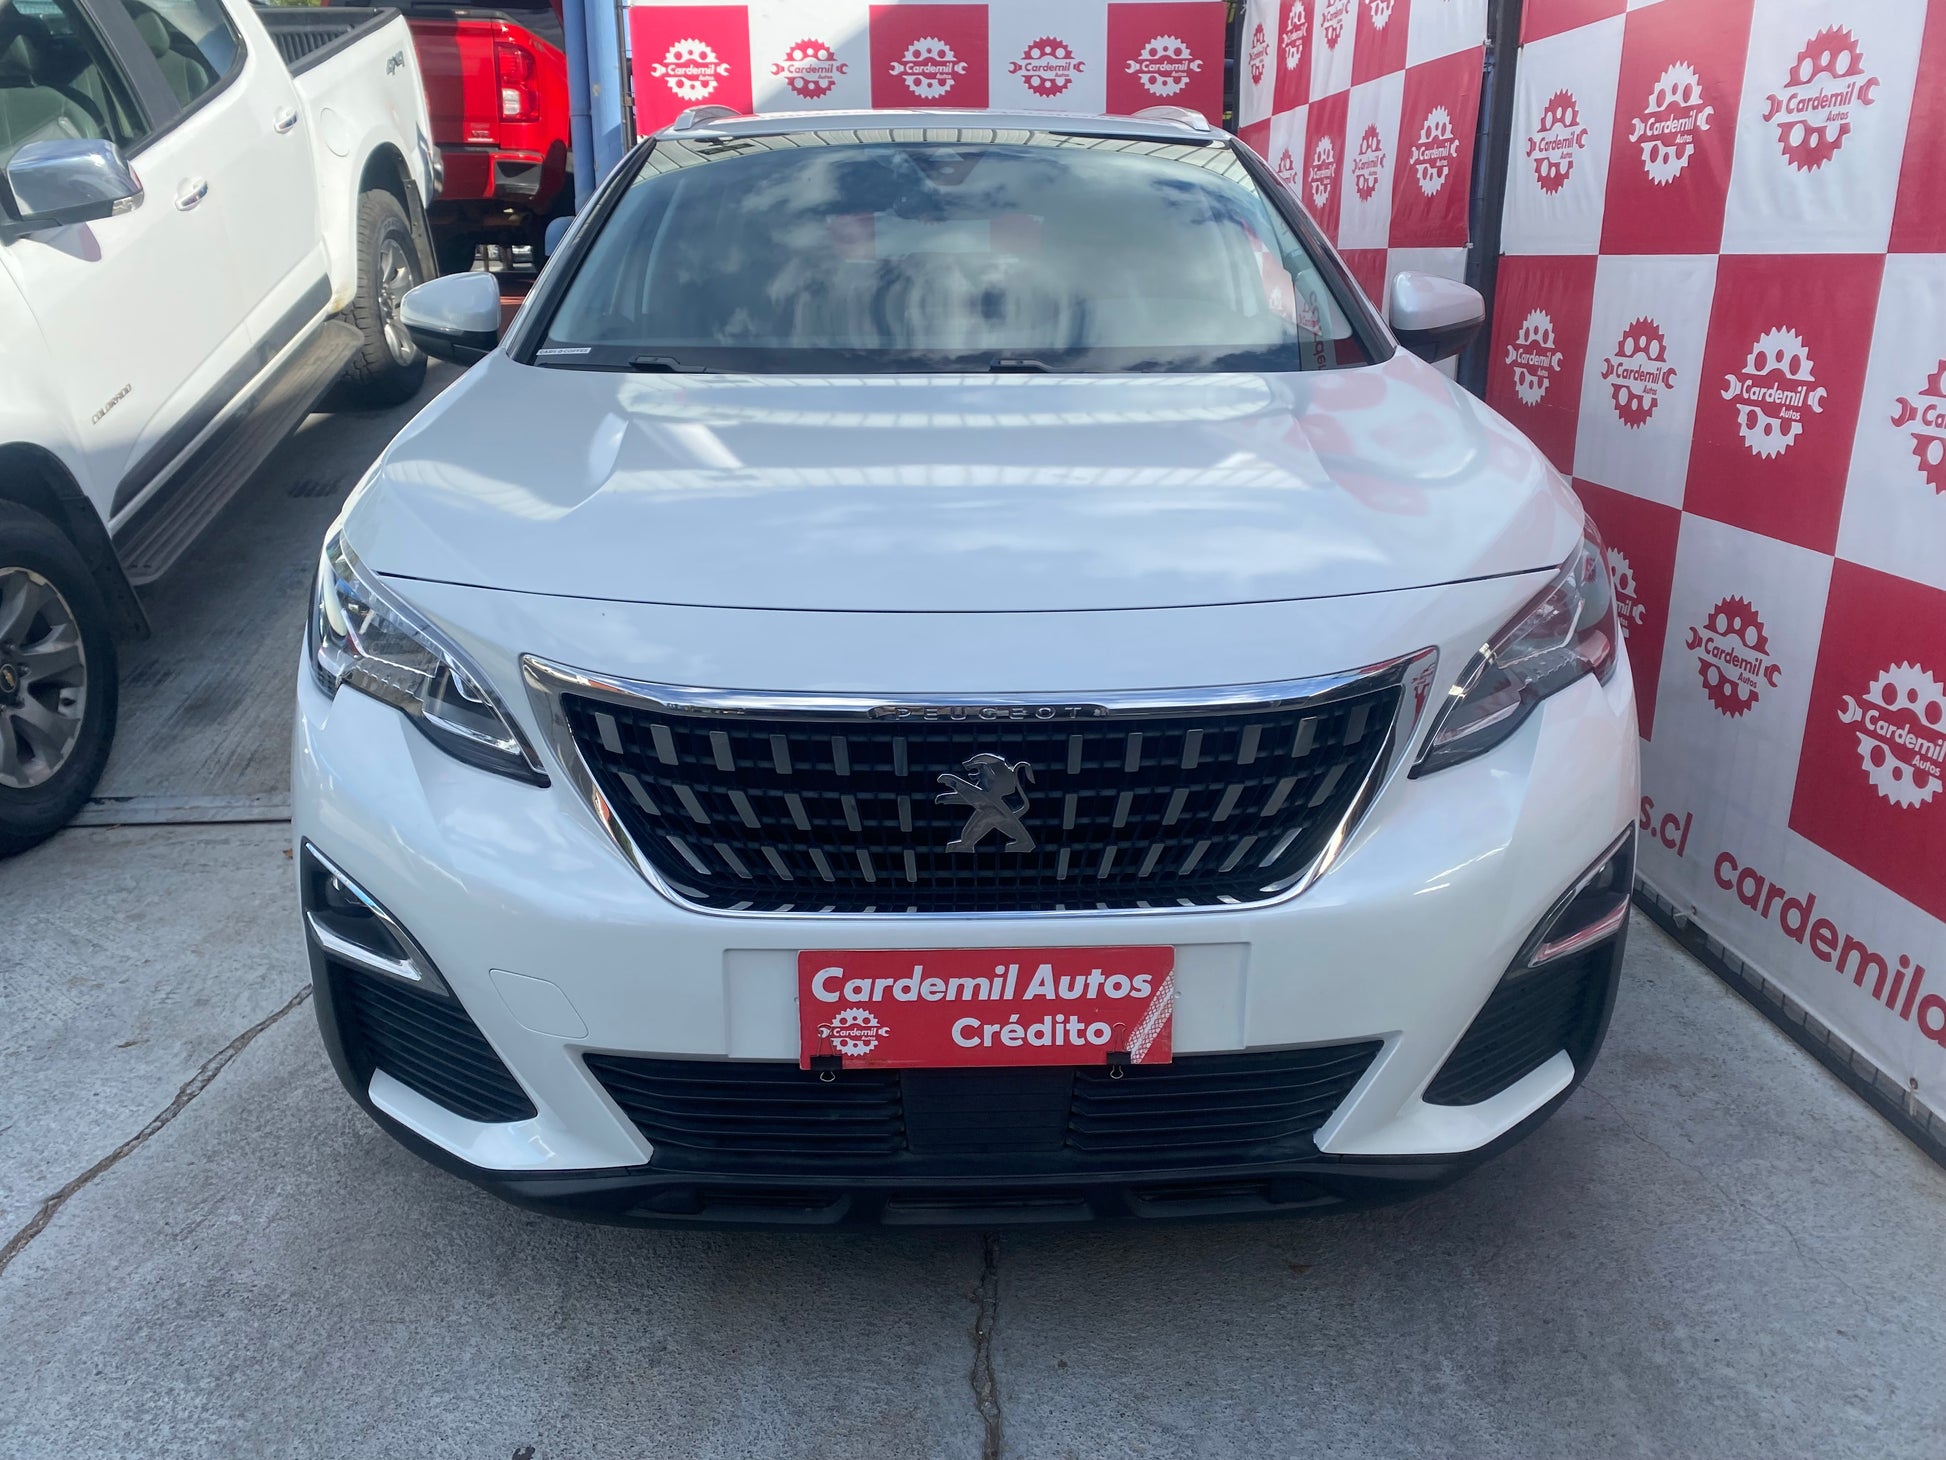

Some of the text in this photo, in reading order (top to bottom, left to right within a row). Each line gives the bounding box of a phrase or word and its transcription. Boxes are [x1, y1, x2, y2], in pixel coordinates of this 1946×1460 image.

[667, 63, 715, 75] Cardemil
[787, 61, 833, 74] Cardemil
[906, 62, 953, 73] Cardemil
[1024, 61, 1071, 72] Cardemil
[1142, 59, 1188, 71] Cardemil
[1786, 81, 1856, 114] Cardemil
[1646, 110, 1697, 136] Cardemil
[1826, 111, 1849, 122] Autos
[1538, 129, 1575, 152] Cardemil
[1675, 133, 1693, 144] Autos
[1419, 142, 1450, 160] Cardemil
[1517, 348, 1552, 368] Cardemil
[1615, 362, 1662, 385] Cardemil
[1642, 385, 1658, 396] Autos
[1742, 379, 1807, 407] Cardemil
[1779, 408, 1801, 420] Autos
[1704, 637, 1763, 677] Cardemil
[1738, 671, 1758, 688] Autos
[895, 706, 1082, 721] PEUGEOT
[1865, 709, 1946, 763] Cardemil
[1911, 754, 1941, 776] Autos
[811, 963, 1152, 1003] Cardemil Autos
[833, 1027, 877, 1036] Cardemil
[951, 1013, 1112, 1048] Crédito
